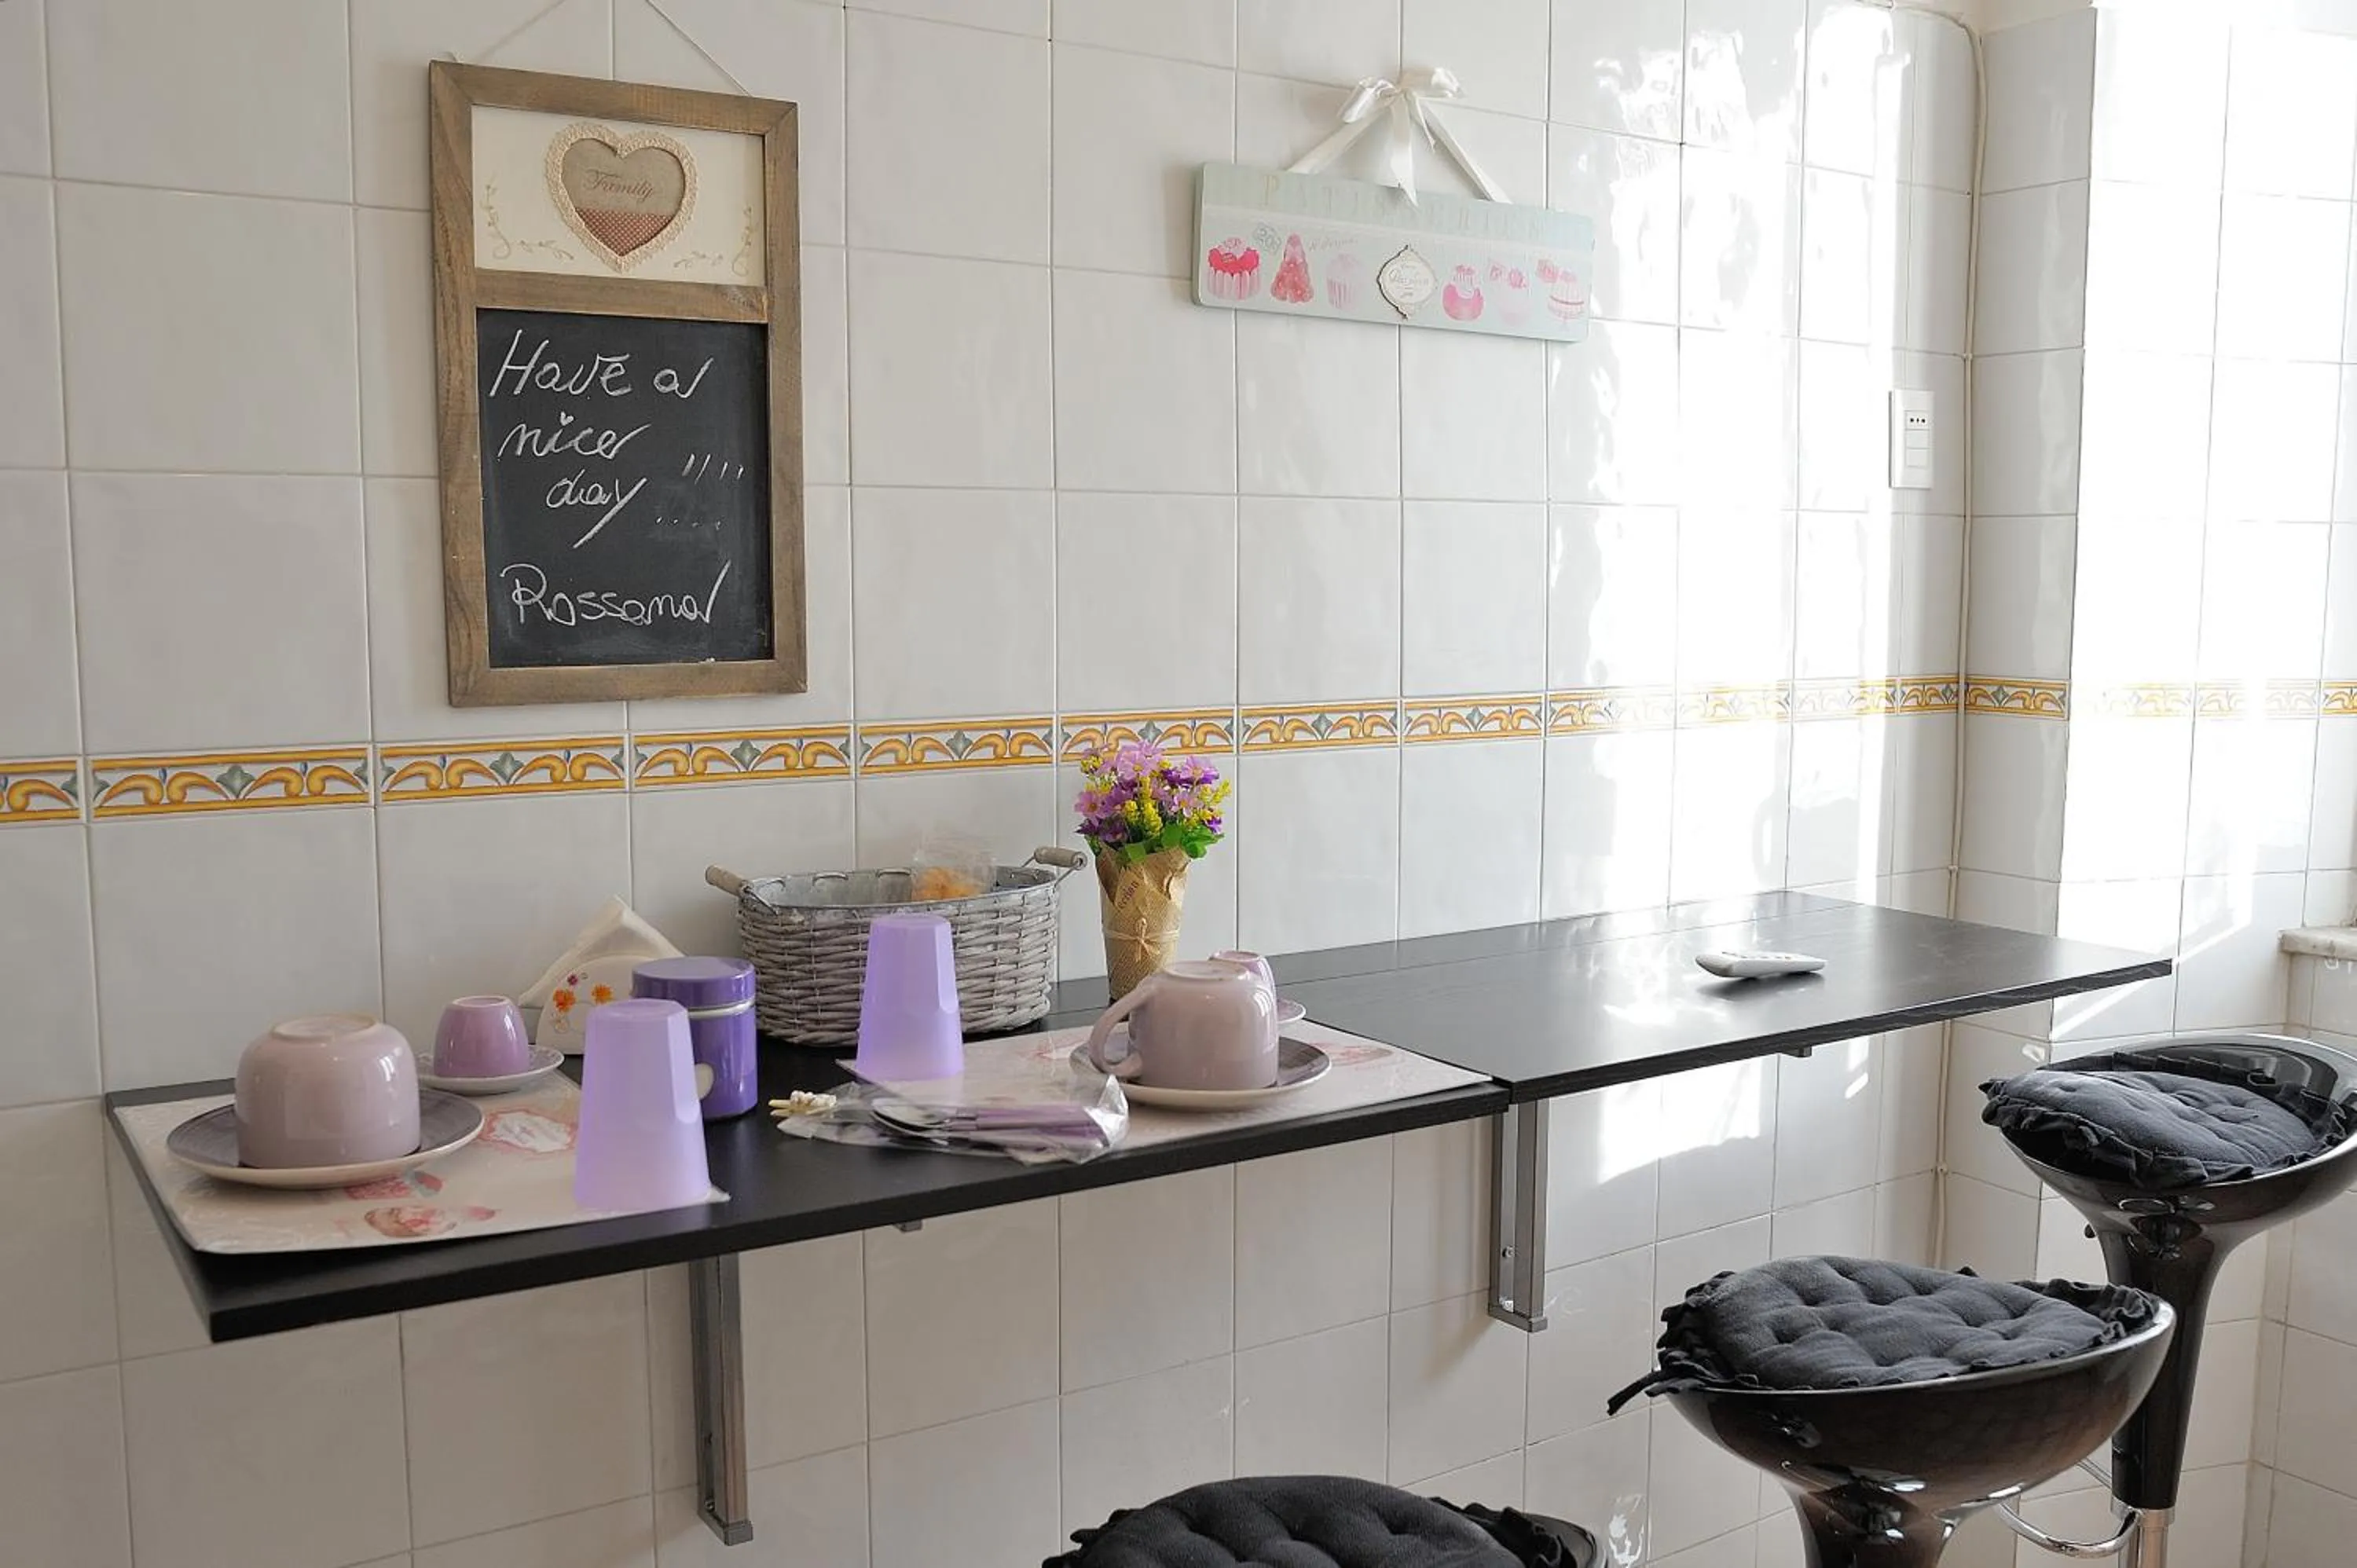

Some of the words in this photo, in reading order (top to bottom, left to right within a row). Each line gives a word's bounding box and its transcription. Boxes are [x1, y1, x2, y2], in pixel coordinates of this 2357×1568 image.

[583, 167, 659, 202] Family
[489, 328, 632, 396] Have
[653, 357, 714, 398] a
[497, 410, 651, 460] nice
[544, 468, 647, 548] day
